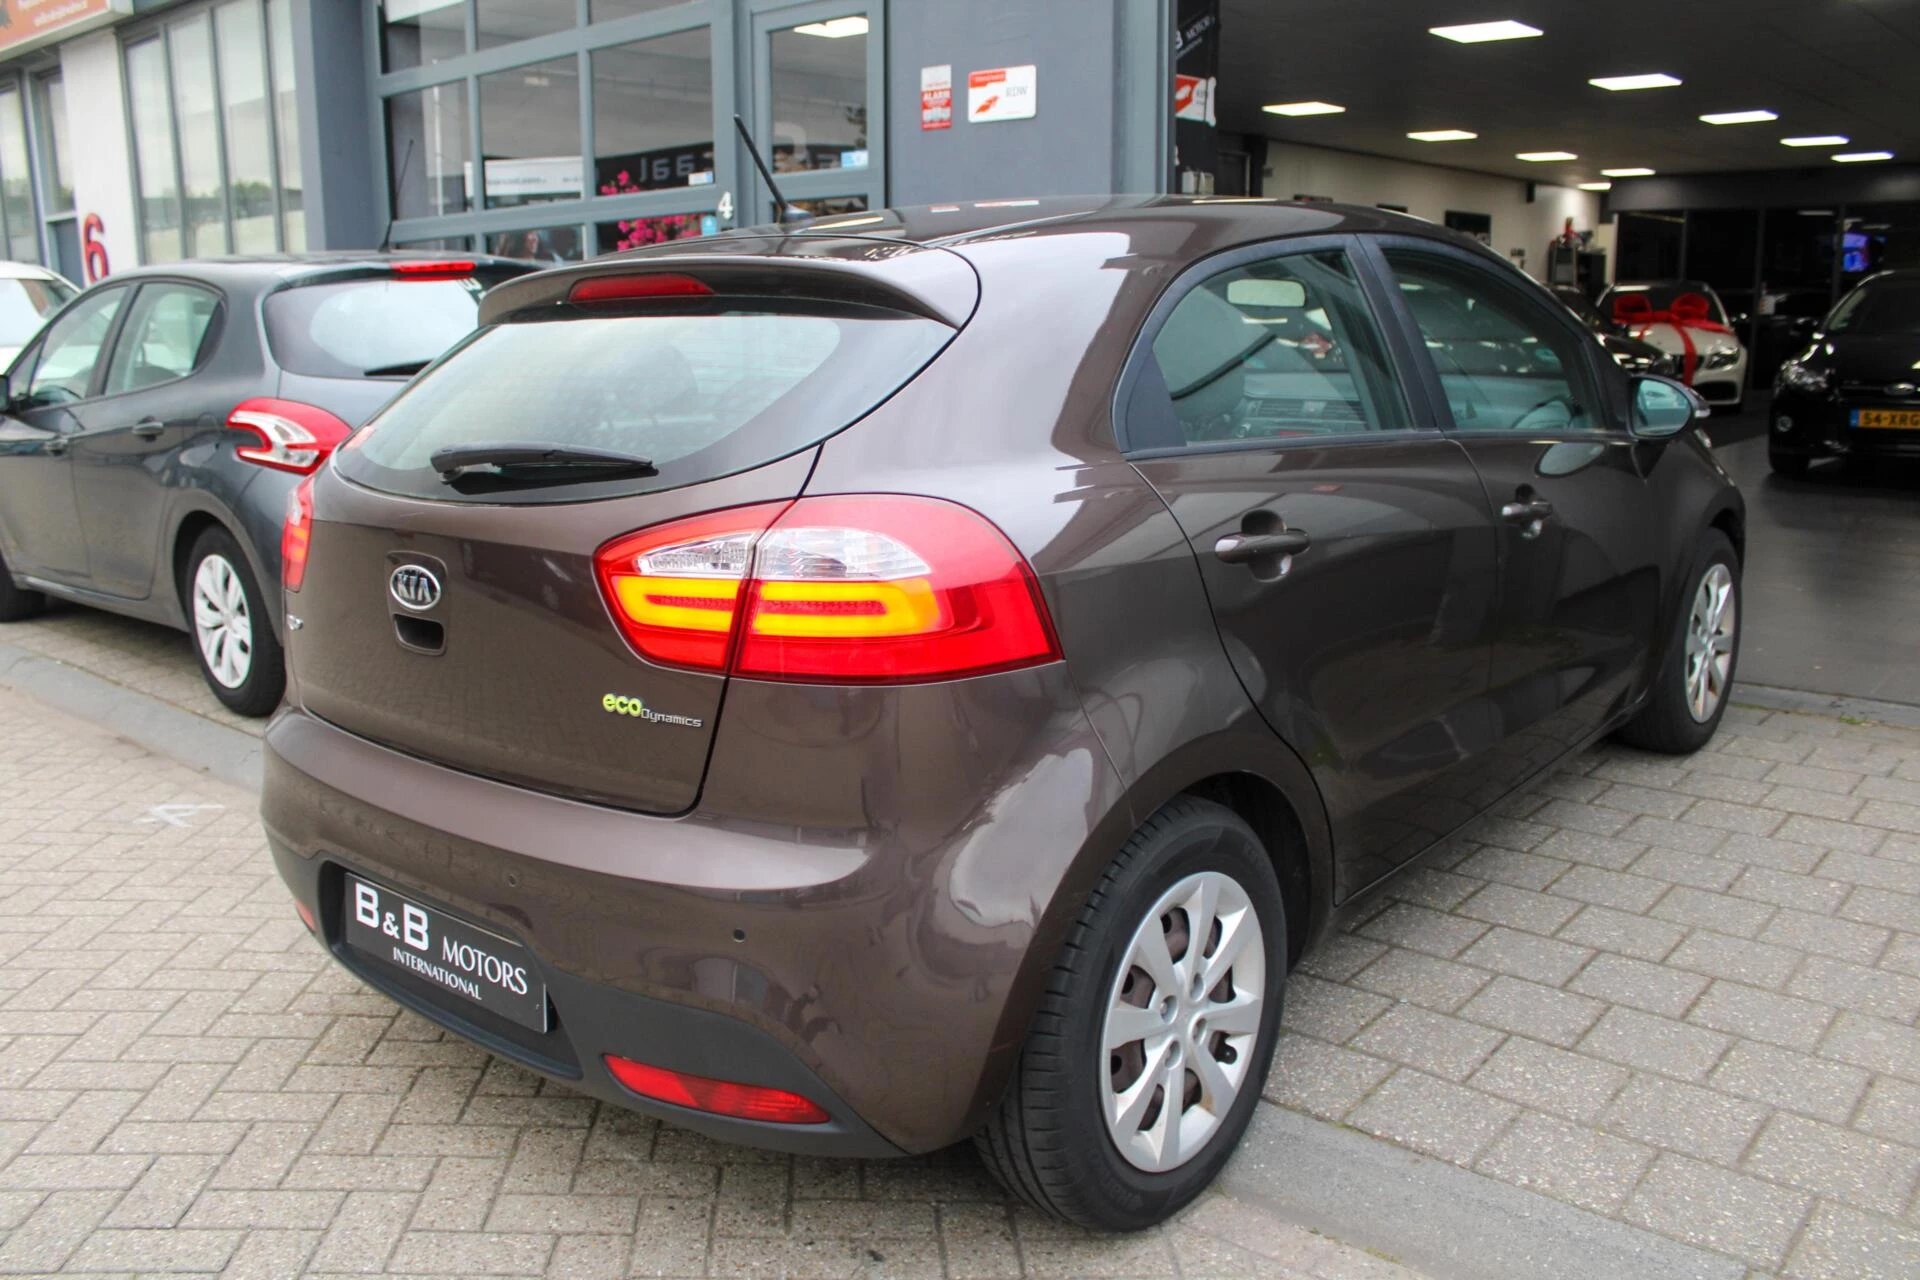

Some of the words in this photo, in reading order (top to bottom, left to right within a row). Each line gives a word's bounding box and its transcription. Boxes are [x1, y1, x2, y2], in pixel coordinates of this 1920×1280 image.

[718, 191, 733, 220] 4
[83, 213, 109, 284] 6
[396, 573, 433, 603] KIA
[393, 946, 483, 1000] INTERNATIONAL
[442, 935, 528, 995] MOTORS
